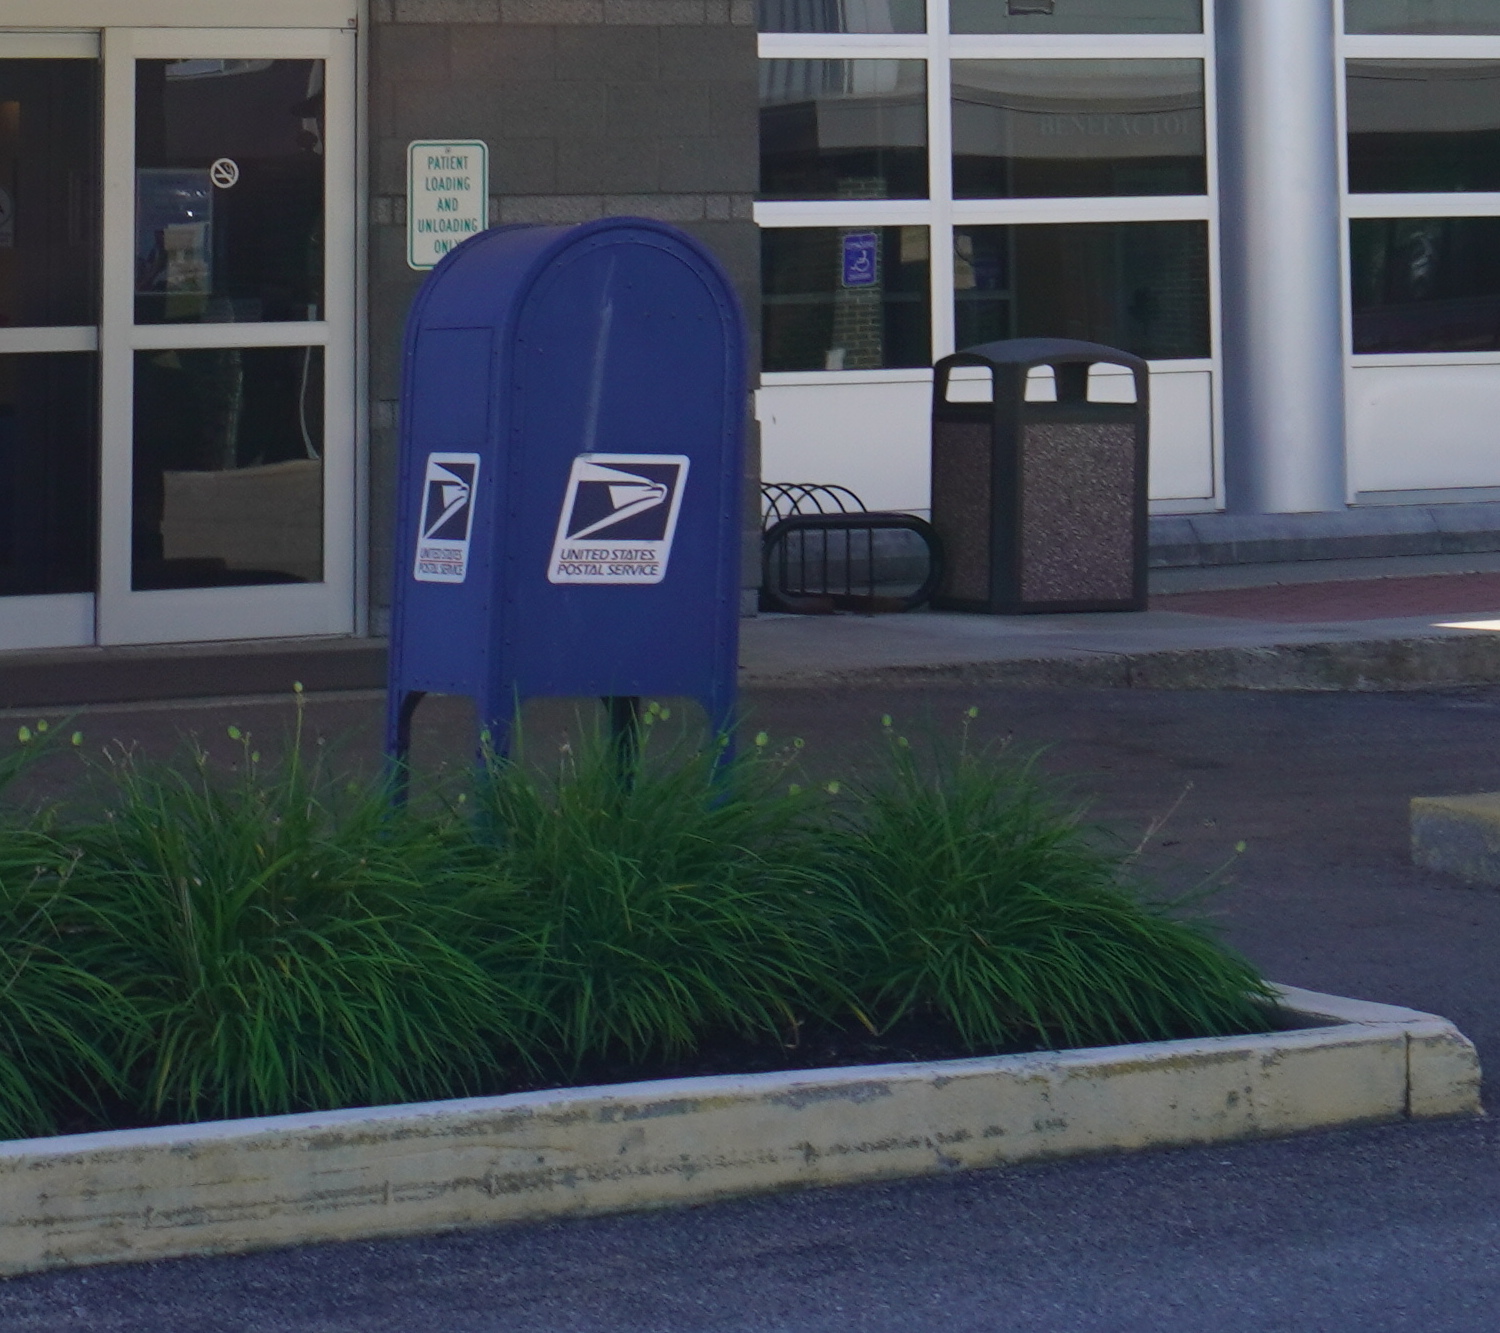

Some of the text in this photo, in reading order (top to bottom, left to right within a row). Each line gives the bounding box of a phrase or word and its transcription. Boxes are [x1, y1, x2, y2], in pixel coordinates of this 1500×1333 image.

[428, 156, 468, 171] PATIENT
[425, 176, 471, 192] LOADING
[437, 197, 458, 212] AND
[418, 218, 478, 233] UNLOADING
[560, 549, 656, 560] UNITED STATES
[557, 564, 660, 576] POSTAL SERVICE
